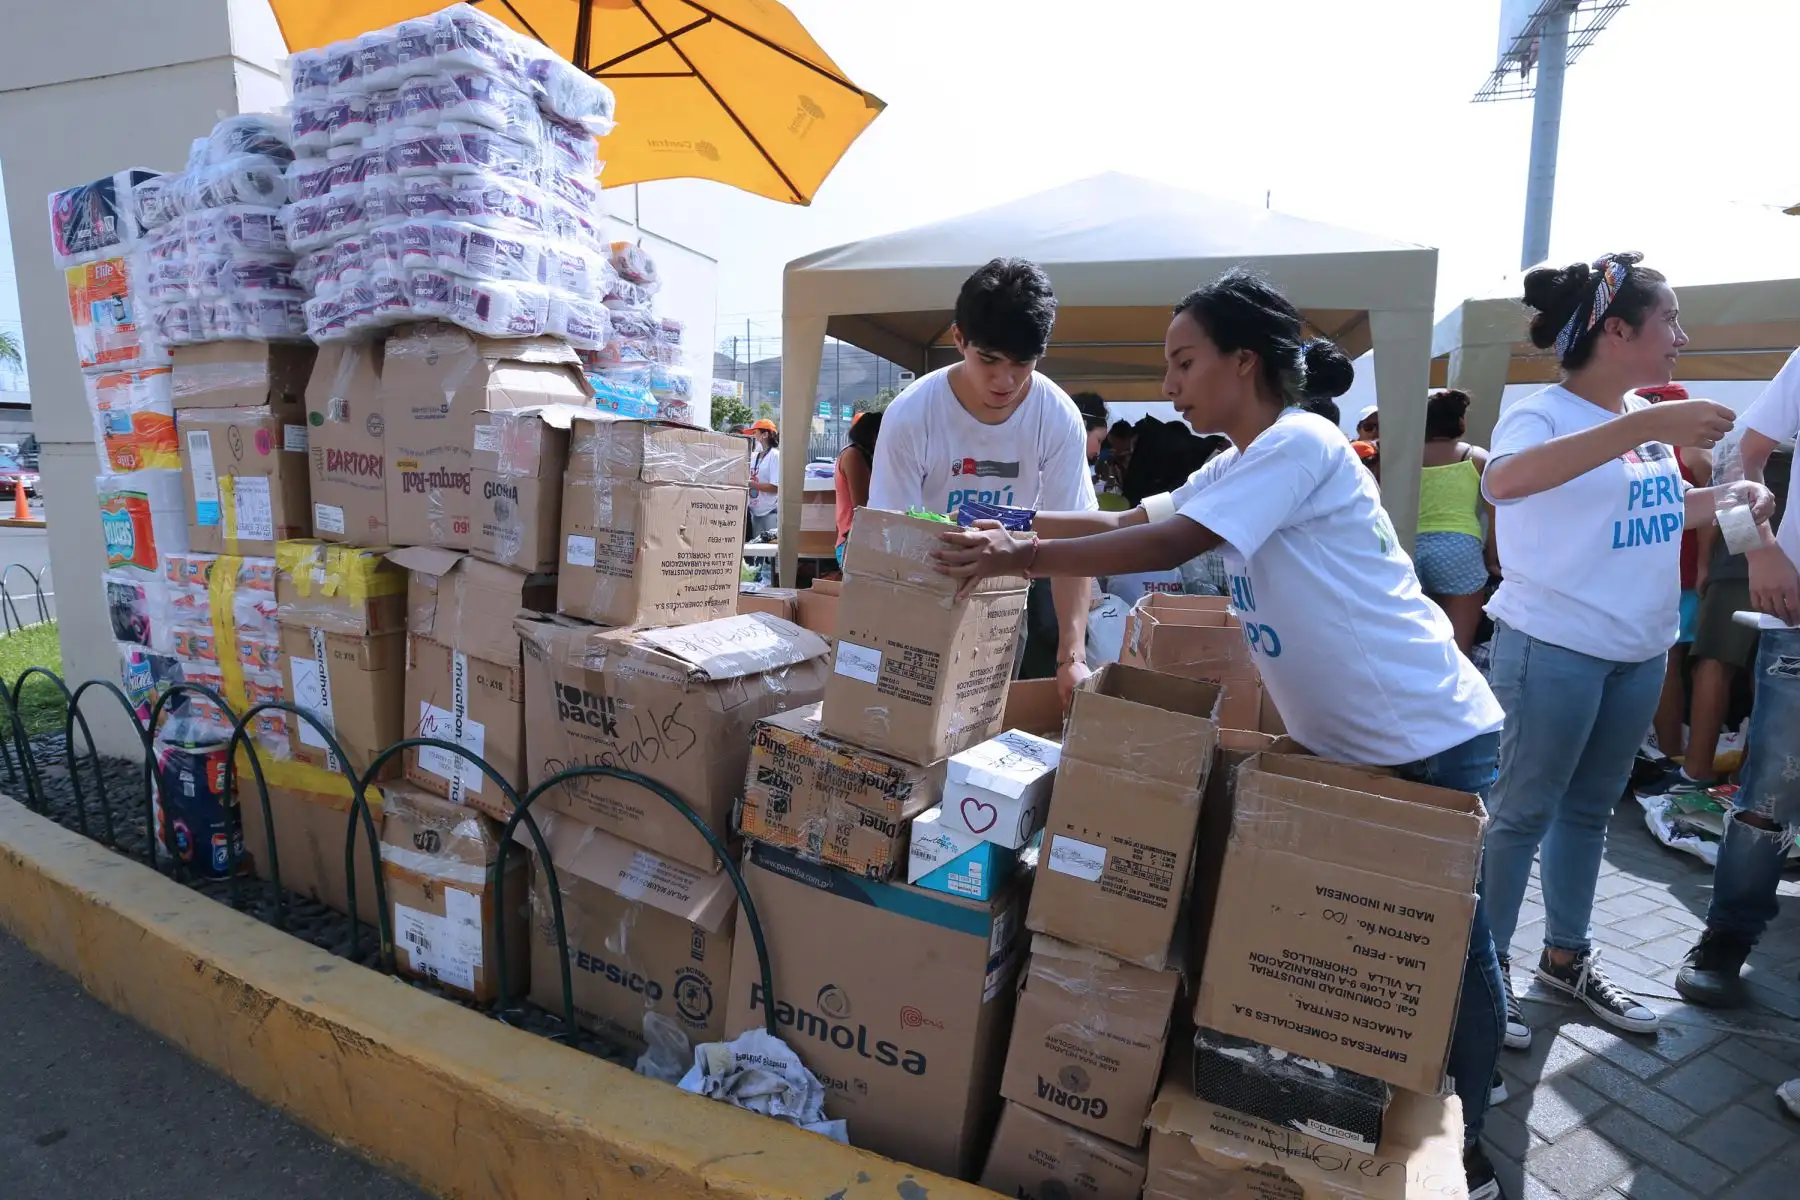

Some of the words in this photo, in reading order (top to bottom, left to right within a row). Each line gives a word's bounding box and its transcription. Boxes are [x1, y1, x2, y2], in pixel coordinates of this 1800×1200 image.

[95, 265, 113, 280] Elite
[401, 466, 471, 495] Barqui-Roll
[484, 481, 518, 504] GLORIA
[691, 501, 718, 509] INDONESIA
[455, 662, 466, 739] marathon
[558, 700, 620, 738] pack
[1315, 885, 1381, 909] INDONESIA
[1382, 903, 1396, 915] IN
[1399, 905, 1435, 923] MADE
[1378, 925, 1430, 946] CARTON
[1352, 944, 1386, 960] PERU
[1249, 951, 1335, 983] URBANIZACION
[1282, 949, 1358, 977] CHORRILLOS
[1396, 955, 1426, 971] LIMA
[1248, 963, 1316, 989] INDUSTRIAL
[1338, 976, 1356, 989] 9-A
[1368, 972, 1402, 988] VILLA
[1319, 983, 1391, 1010] COMUNIDAD
[1360, 982, 1385, 995] Lote
[1388, 989, 1397, 999] A
[1405, 982, 1422, 993] LA
[1400, 992, 1420, 1006] Mz.
[1231, 1004, 1252, 1017] S.A.
[1295, 999, 1349, 1022] CENTRAL
[1396, 1003, 1417, 1017] Cal.
[1255, 1011, 1338, 1043] COMERCIALES
[1352, 1016, 1413, 1040] ALMACEN
[1044, 1042, 1077, 1059] HELADOS
[1341, 1036, 1407, 1063] EMPRESAS
[1036, 1074, 1108, 1120] GLORIA
[1212, 1110, 1257, 1129] CARTON
[1210, 1123, 1241, 1140] MADE
[1242, 1133, 1255, 1145] IN
[1309, 1119, 1331, 1134] top
[1331, 1125, 1361, 1142] model
